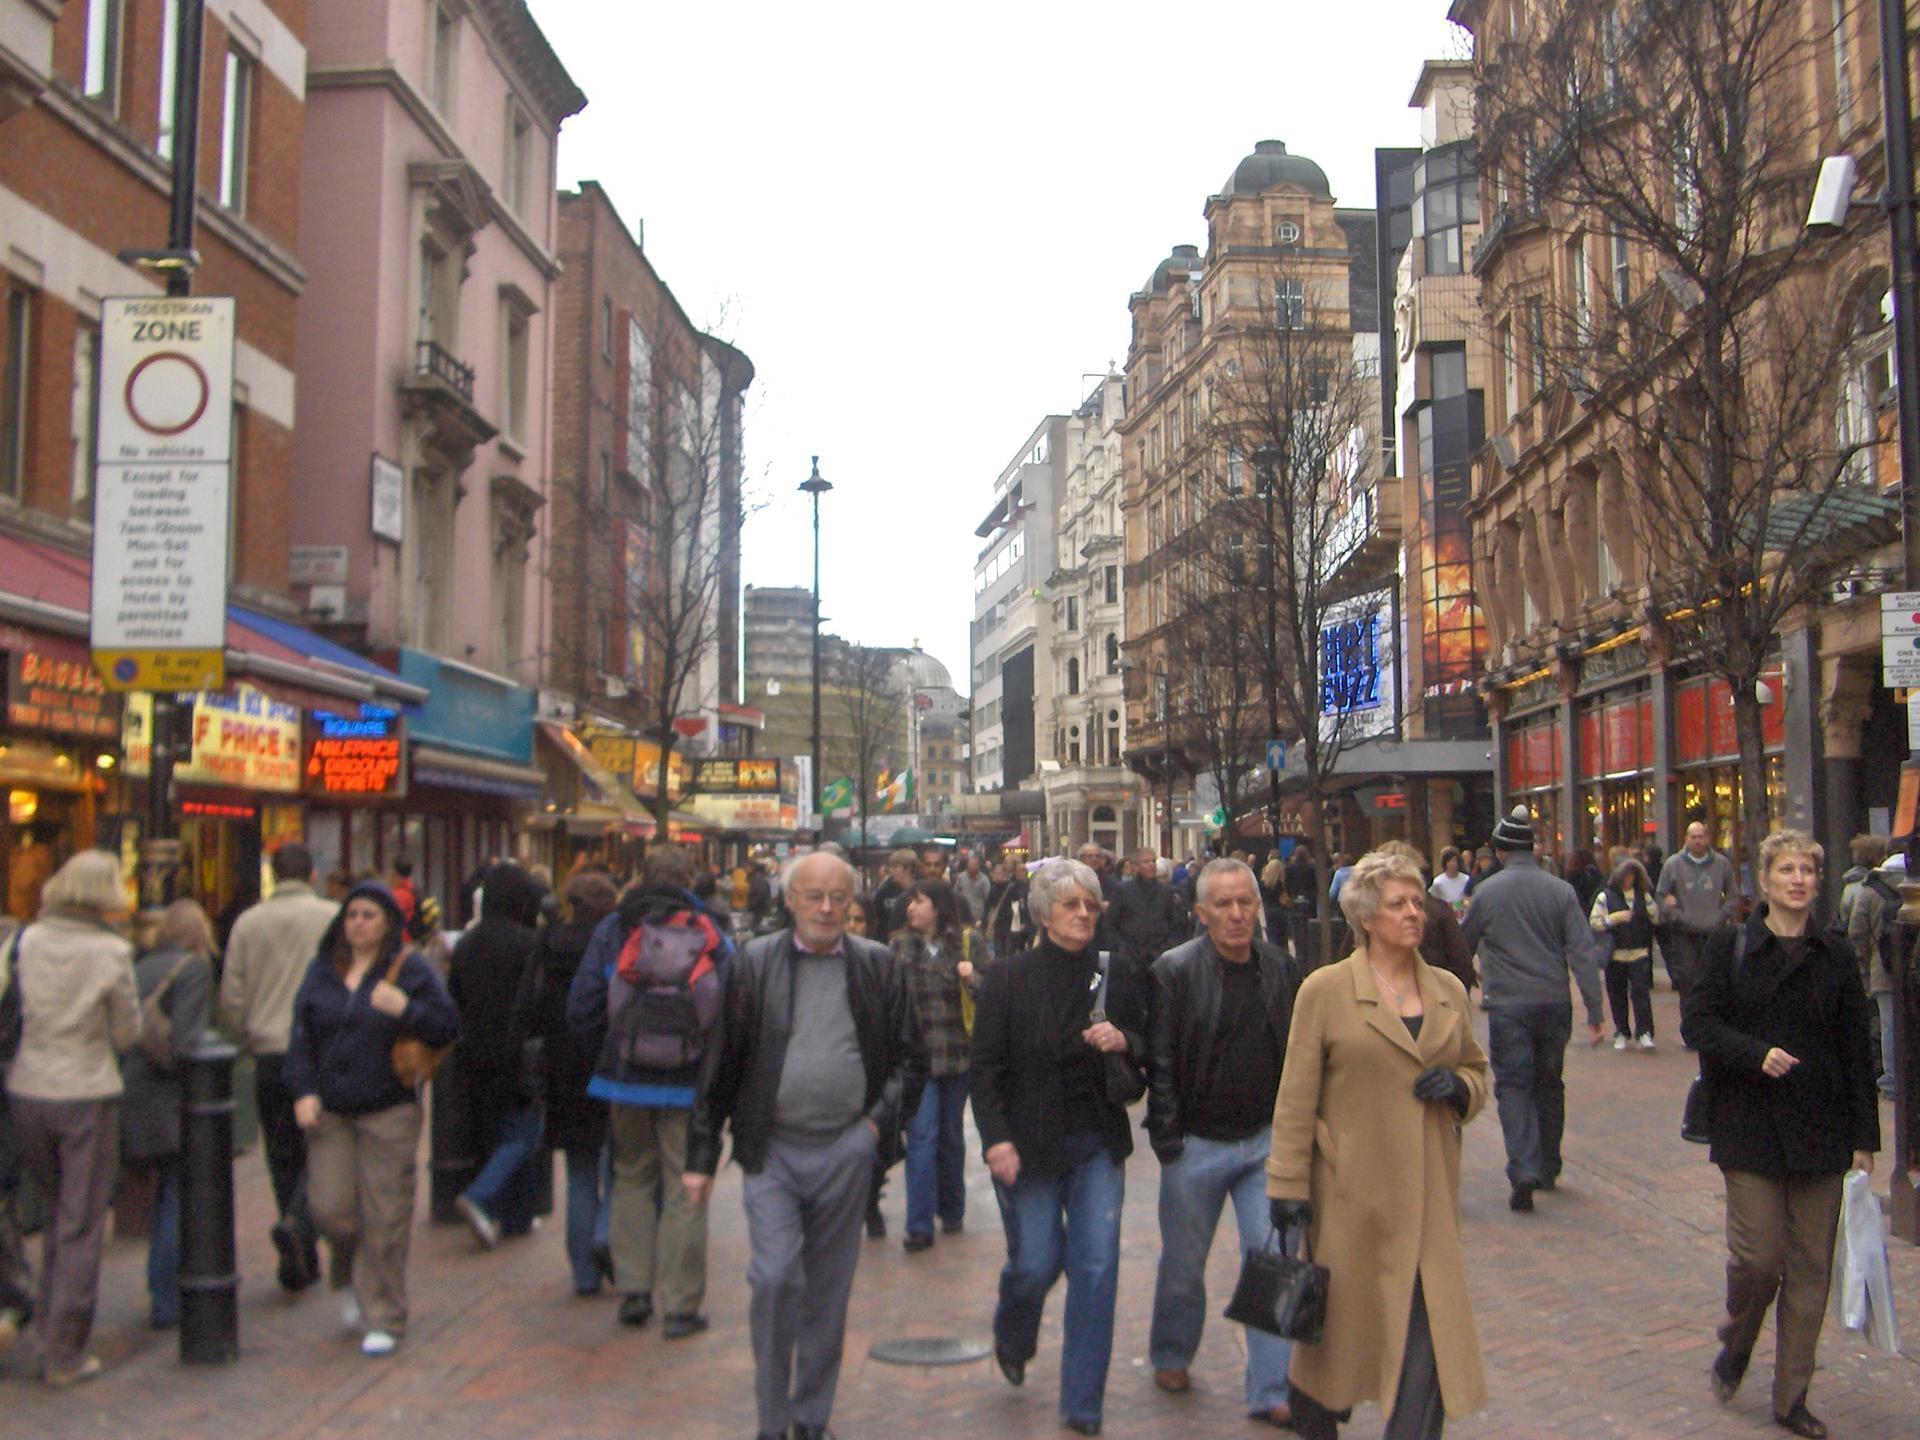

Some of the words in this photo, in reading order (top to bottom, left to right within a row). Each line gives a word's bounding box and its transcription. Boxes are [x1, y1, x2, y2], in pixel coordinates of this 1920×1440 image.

[124, 302, 214, 316] PEDESTRIAN
[132, 320, 202, 342] ZONE
[119, 445, 139, 457] No
[147, 445, 205, 457] vehicles
[121, 470, 172, 484] Except
[179, 470, 199, 482] for
[133, 487, 186, 502] loading
[127, 505, 191, 517] between
[132, 557, 158, 569] and
[165, 556, 184, 568] for
[120, 575, 169, 586] access
[177, 575, 192, 586] to
[168, 592, 186, 605] by
[117, 609, 188, 623] permitted
[124, 628, 183, 639] vehicles
[153, 655, 169, 668] At
[177, 657, 202, 669] any
[221, 719, 280, 758] PRICE
